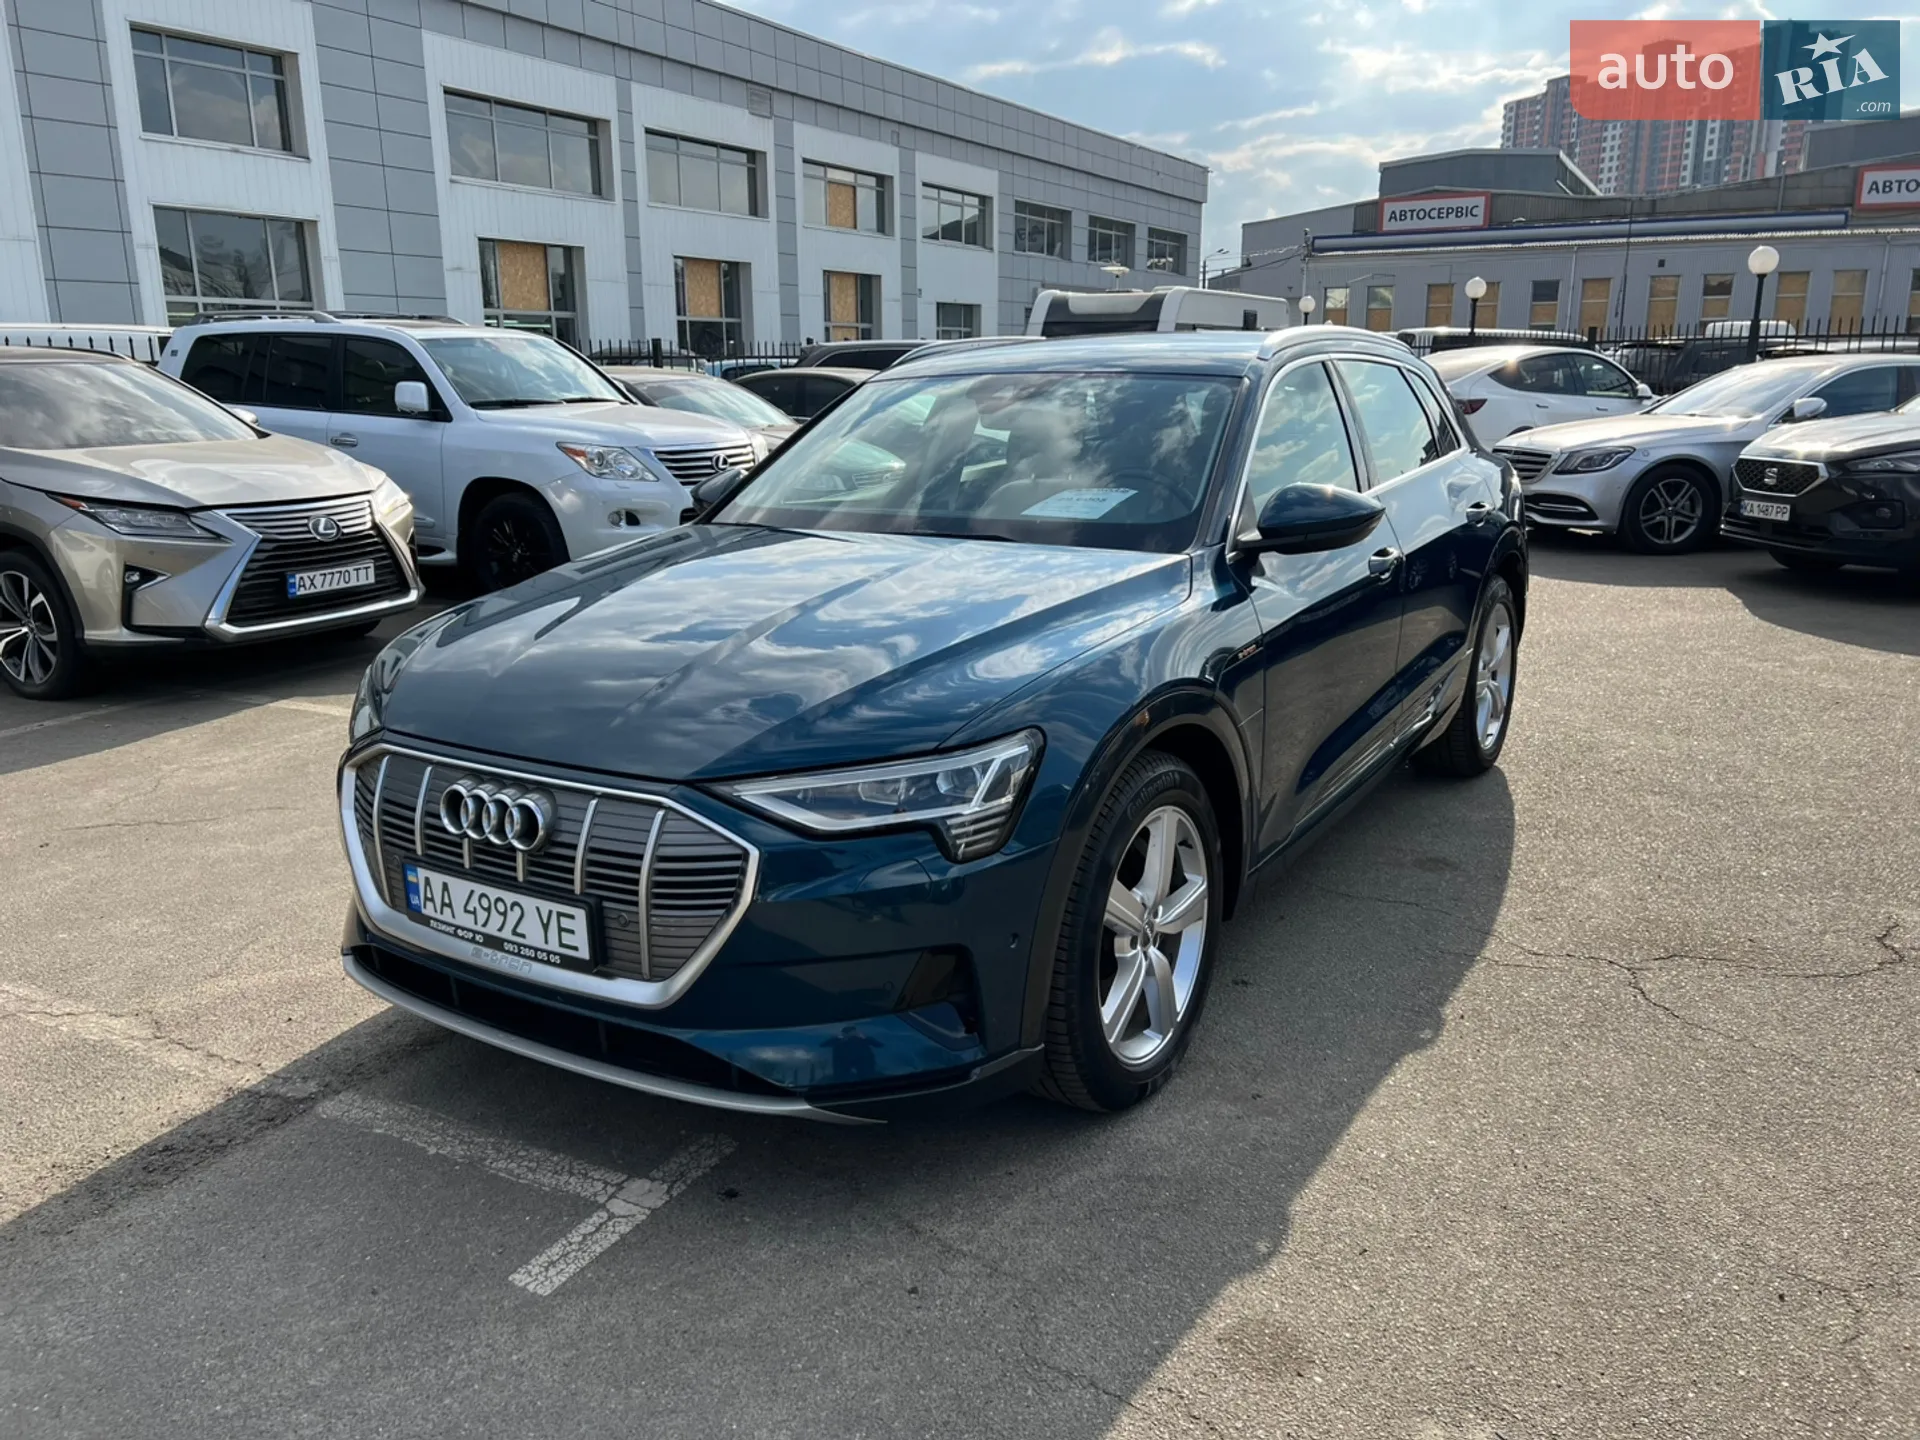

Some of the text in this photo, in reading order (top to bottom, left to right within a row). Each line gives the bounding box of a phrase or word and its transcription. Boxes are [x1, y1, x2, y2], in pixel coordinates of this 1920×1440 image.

[1867, 178, 1920, 195] АВТО
[1388, 204, 1480, 222] АВТОСЕРВІС
[297, 565, 371, 592] AX 7770 TT
[423, 876, 579, 951] AA 4992 YE
